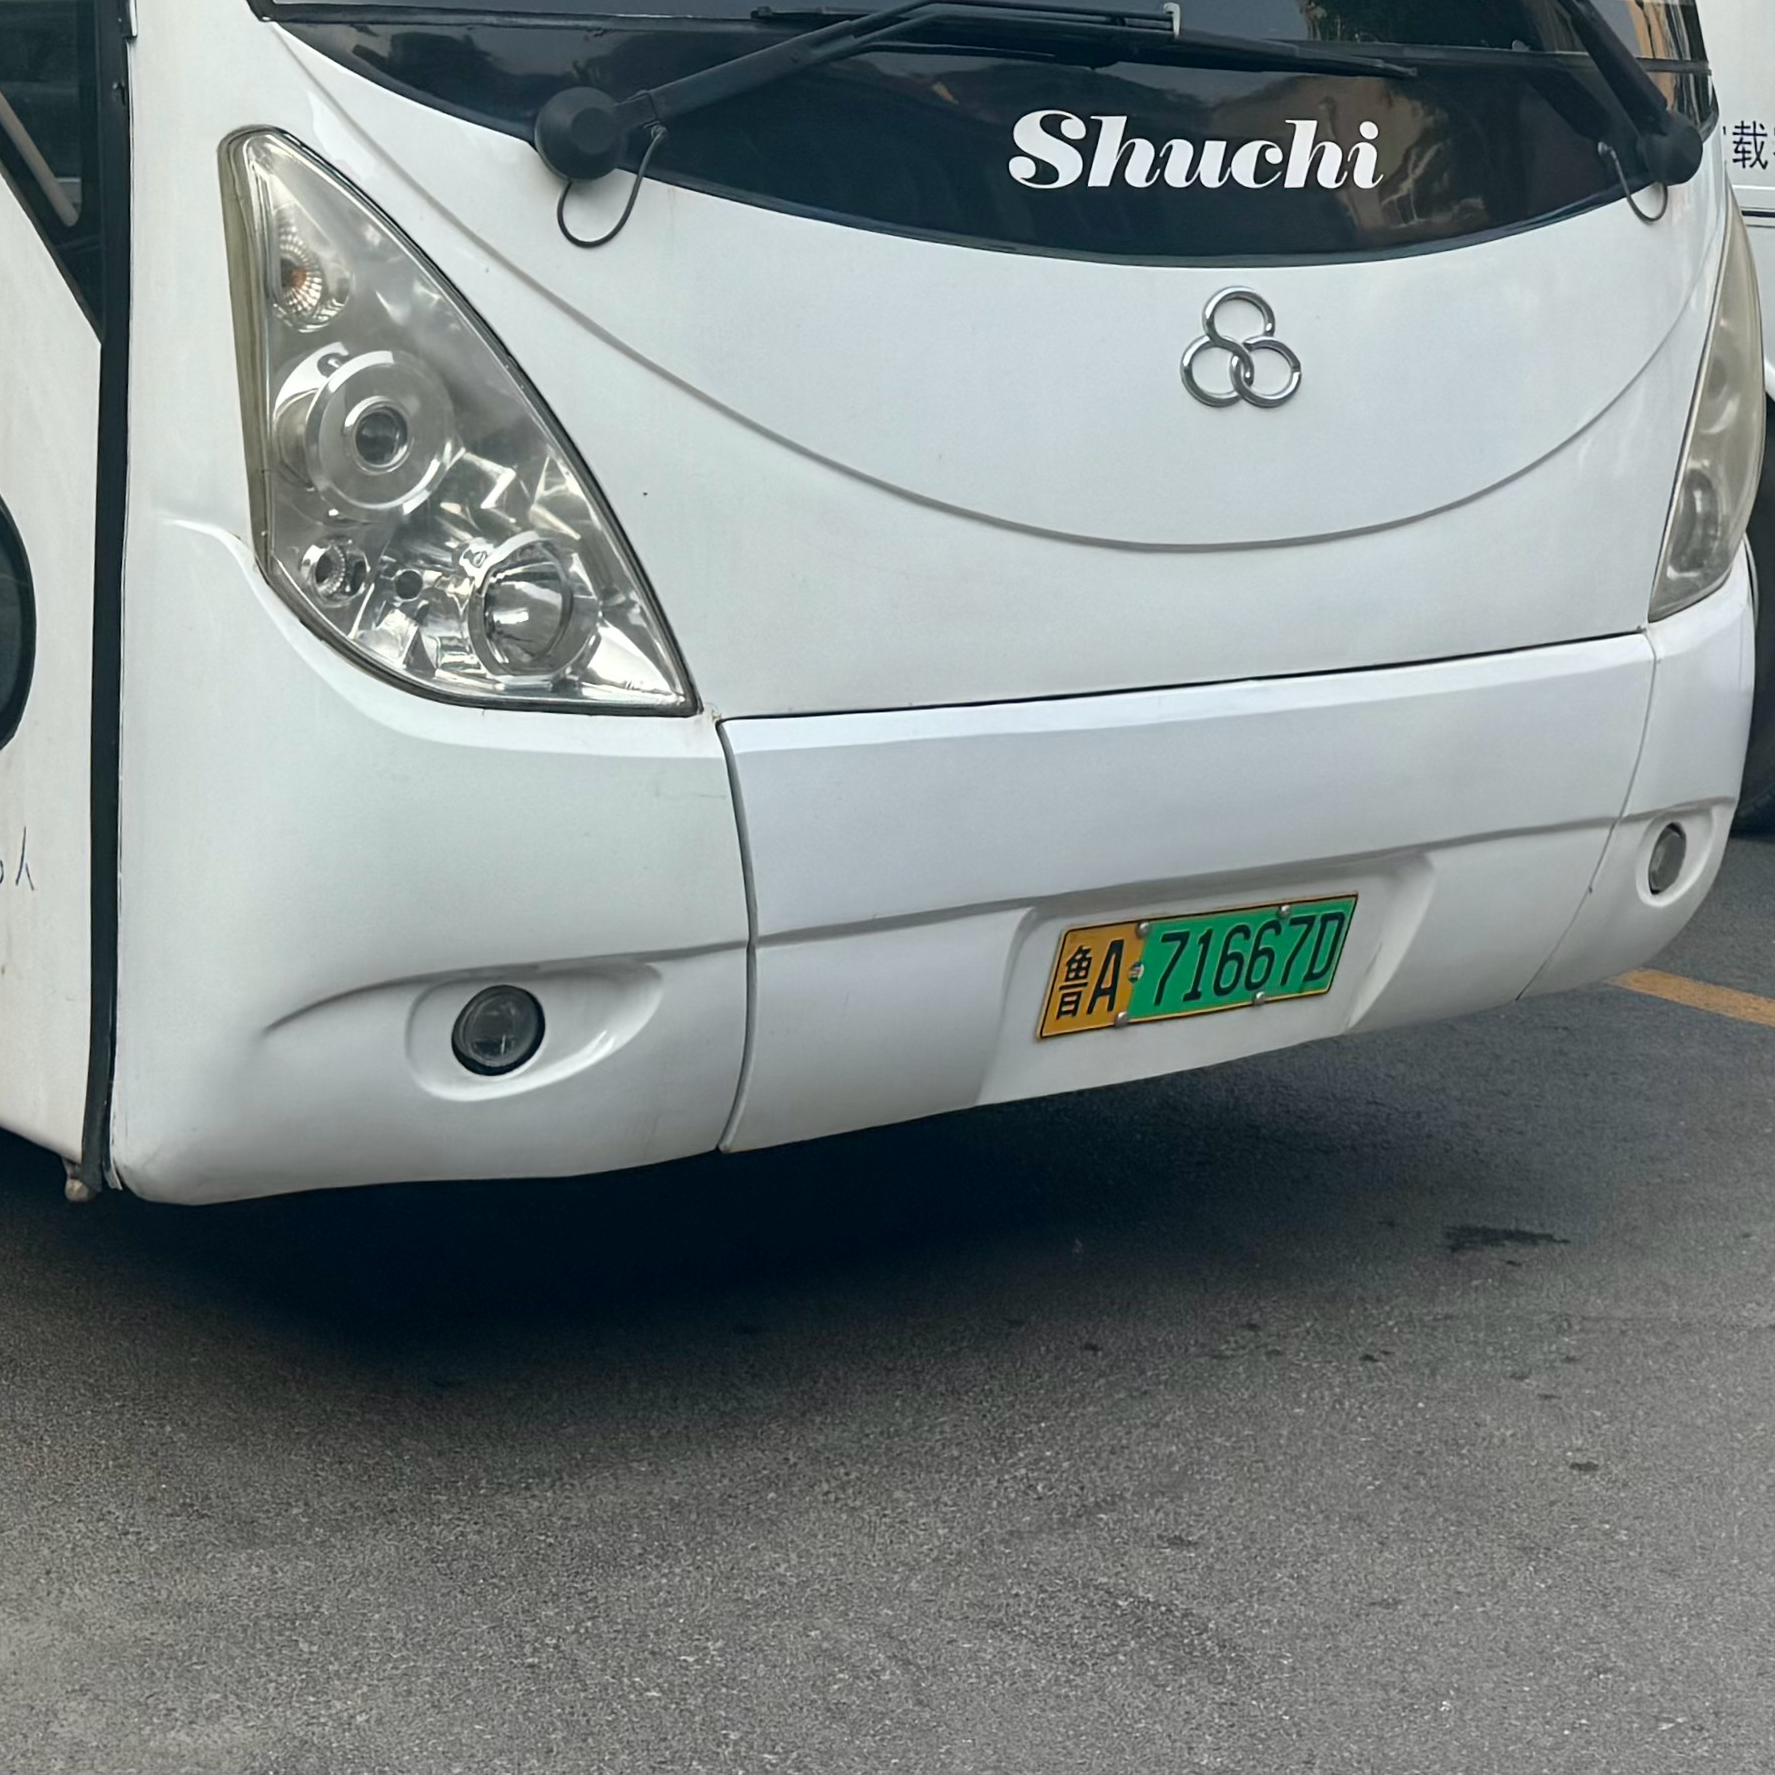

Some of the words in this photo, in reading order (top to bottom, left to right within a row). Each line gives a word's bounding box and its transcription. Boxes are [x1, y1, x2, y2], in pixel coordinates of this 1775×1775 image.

[1008, 108, 1384, 191] Shuchi
[1055, 938, 1126, 1021] 鲁A
[1153, 911, 1346, 1007] 71667D
